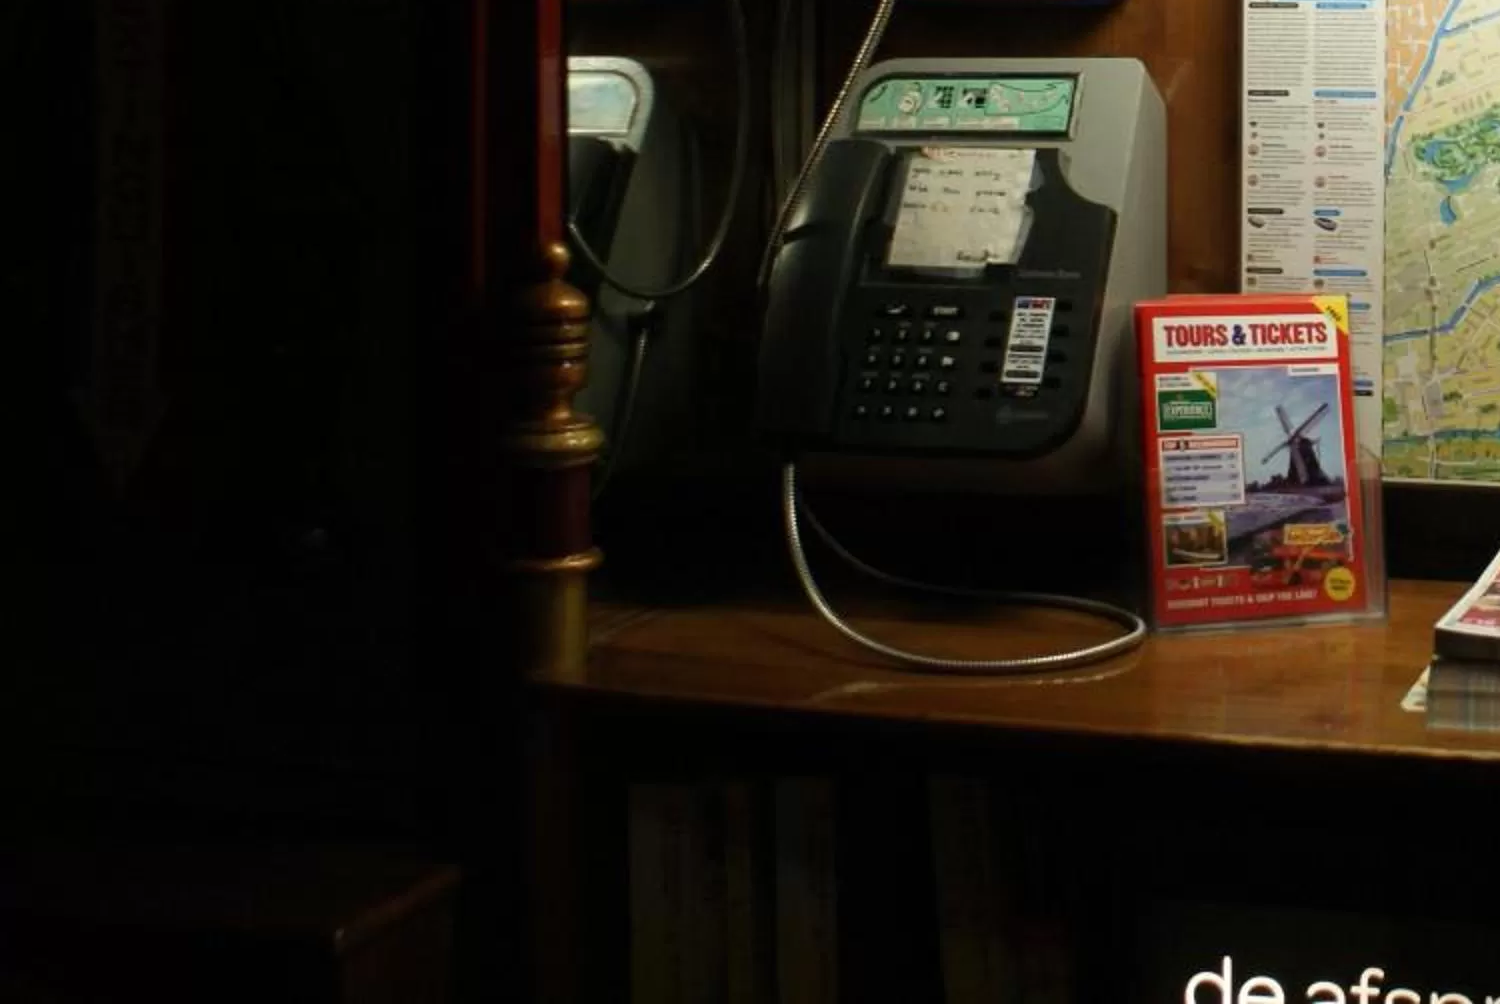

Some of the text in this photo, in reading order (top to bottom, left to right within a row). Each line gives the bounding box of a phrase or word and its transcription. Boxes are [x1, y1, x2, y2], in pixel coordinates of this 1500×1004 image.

[1163, 322, 1327, 347] TOURS & TICKETS
